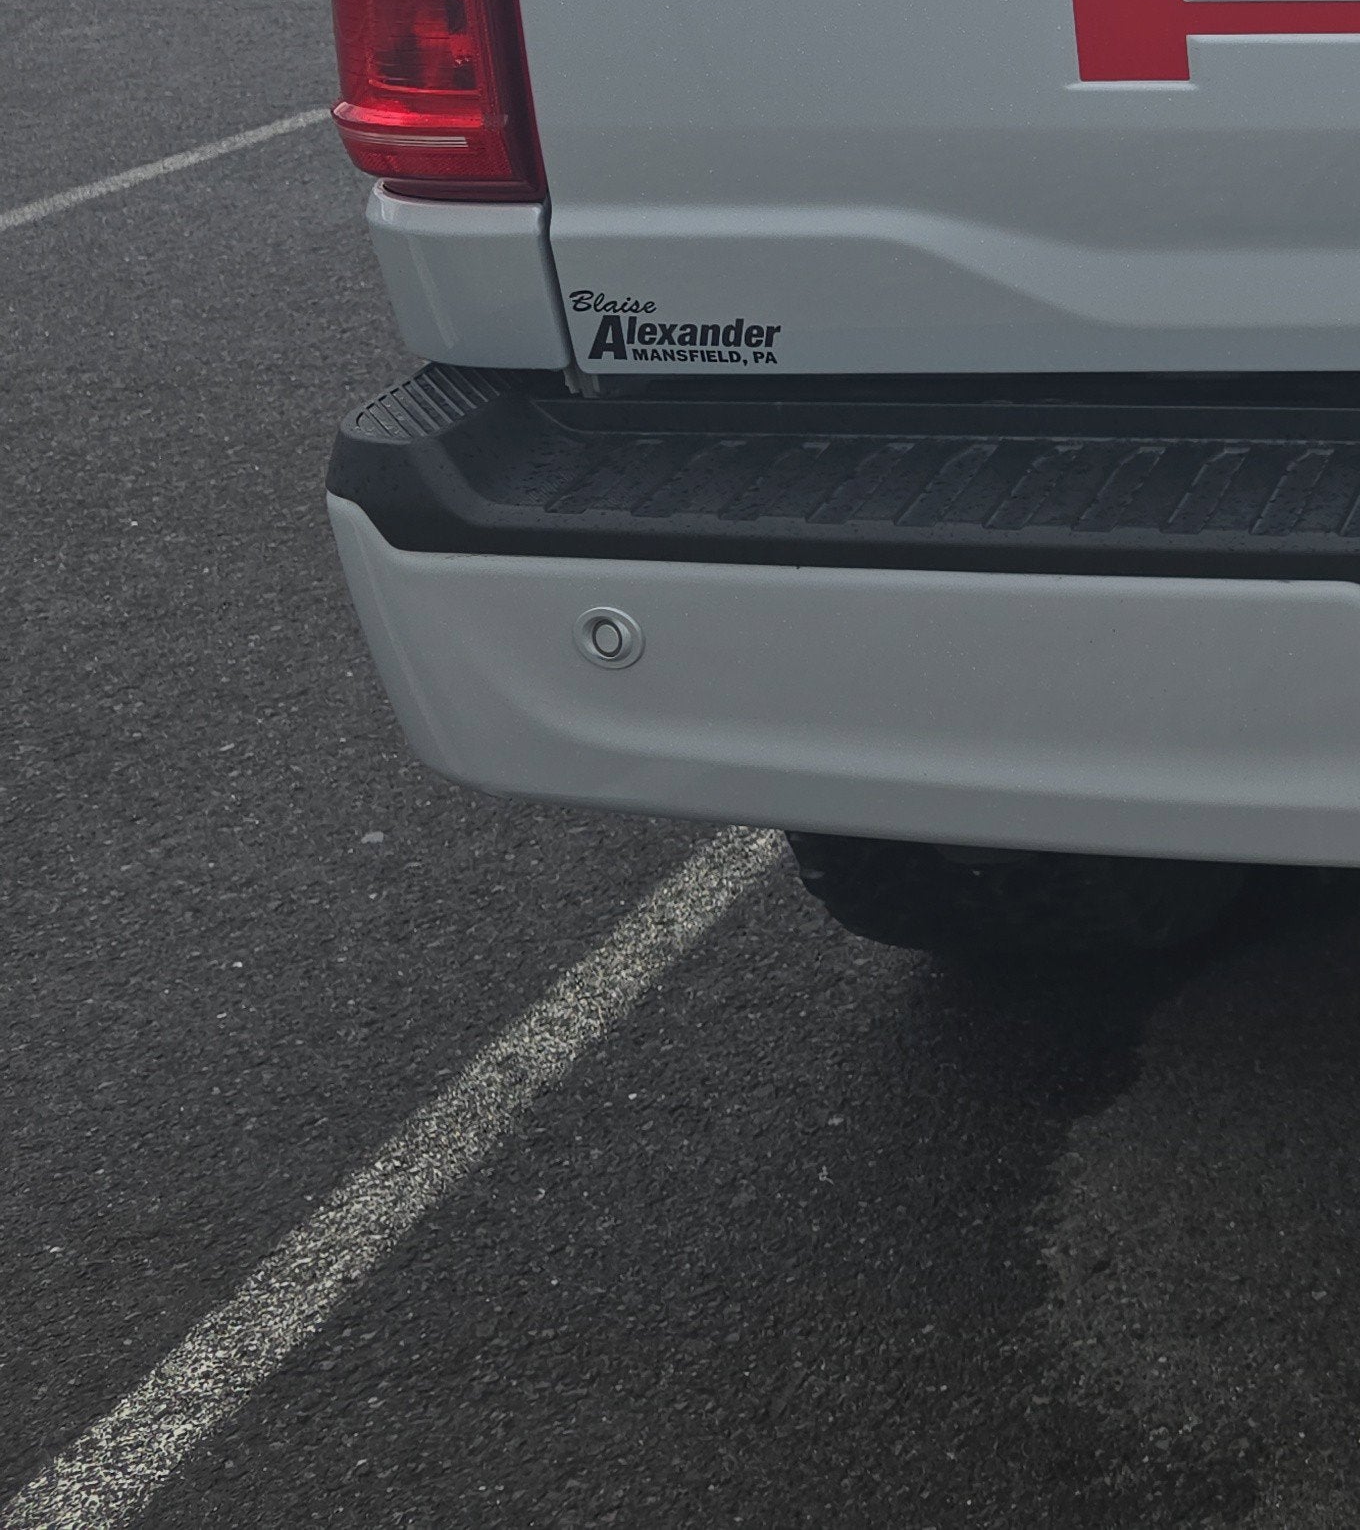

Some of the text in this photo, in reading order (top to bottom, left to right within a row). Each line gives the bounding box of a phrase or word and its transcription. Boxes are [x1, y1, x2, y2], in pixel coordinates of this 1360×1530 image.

[569, 290, 656, 314] Blaise
[588, 315, 781, 360] Alexander
[632, 348, 778, 366] MANSFIELD, PA
